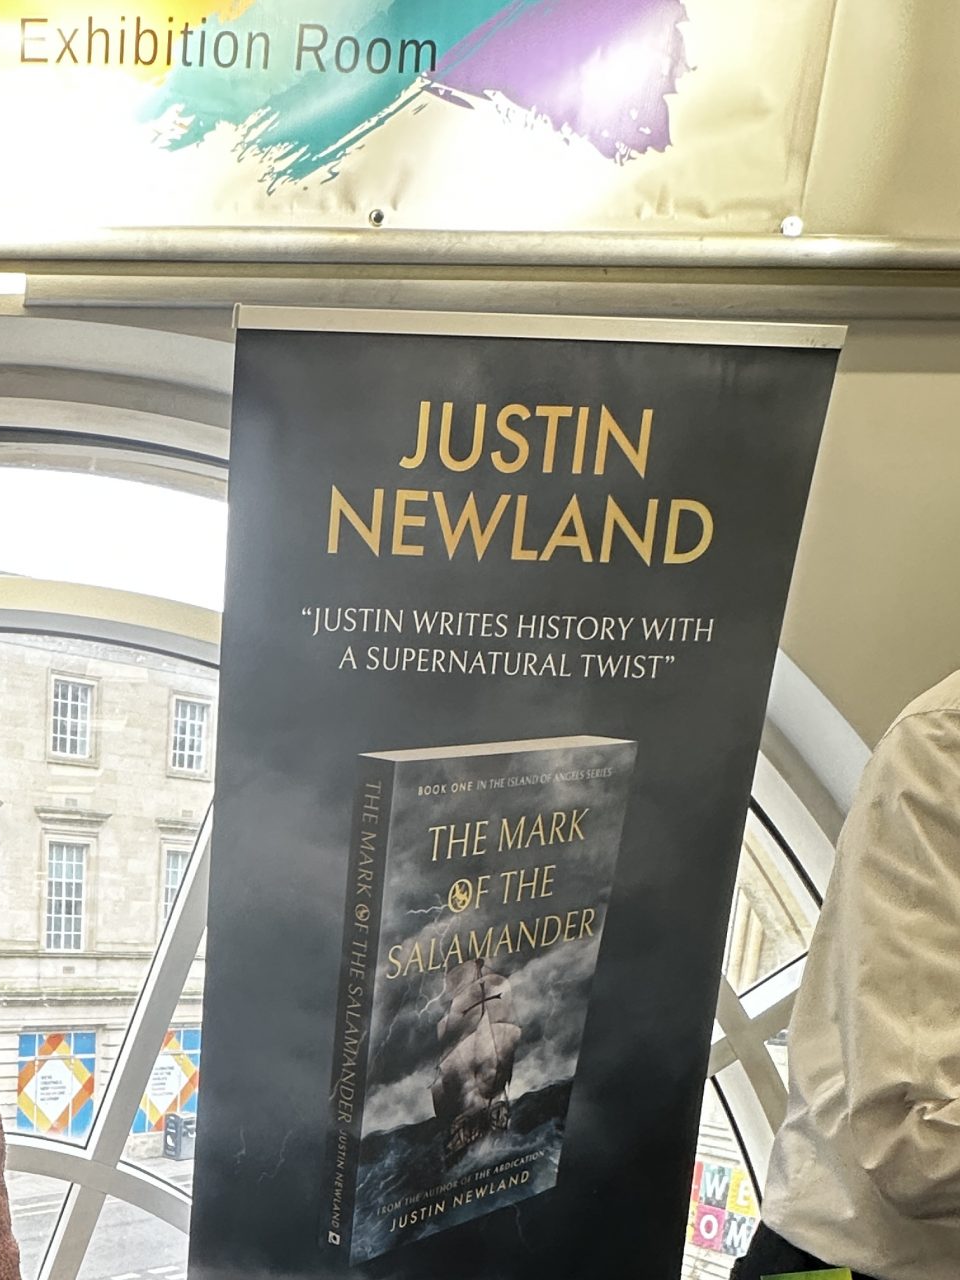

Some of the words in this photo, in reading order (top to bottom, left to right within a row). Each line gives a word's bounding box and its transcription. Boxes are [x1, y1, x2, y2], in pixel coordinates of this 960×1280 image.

[20, 16, 271, 69] Exhibition
[295, 23, 438, 74] Room
[399, 400, 653, 479] JUSTIN
[327, 484, 714, 567] NEWLAND
[412, 609, 508, 638] WRITES
[516, 613, 633, 641] HISTORY
[641, 616, 714, 642] WITH
[339, 648, 358, 670] A
[366, 647, 571, 678] SUPERNATURAL
[362, 780, 382, 825] THE
[418, 784, 447, 796] BOOK
[451, 781, 473, 793] ONE
[476, 780, 487, 791] IN
[489, 778, 505, 789] THE
[507, 775, 538, 788] ISLAND
[428, 820, 489, 862] THE
[497, 807, 590, 852] MARK
[356, 833, 376, 897] MARK
[447, 875, 491, 914] OF
[500, 864, 556, 904] THE
[351, 936, 369, 982] THE
[386, 908, 595, 980] SALAMANDER
[339, 985, 364, 1123] SALAMANDER
[337, 1130, 347, 1169] JUSTIN
[474, 1168, 491, 1180] THE
[331, 1171, 344, 1229] NEWLAND
[390, 1201, 445, 1232] JUSTIN
[453, 1170, 530, 1208] NEWLAND
